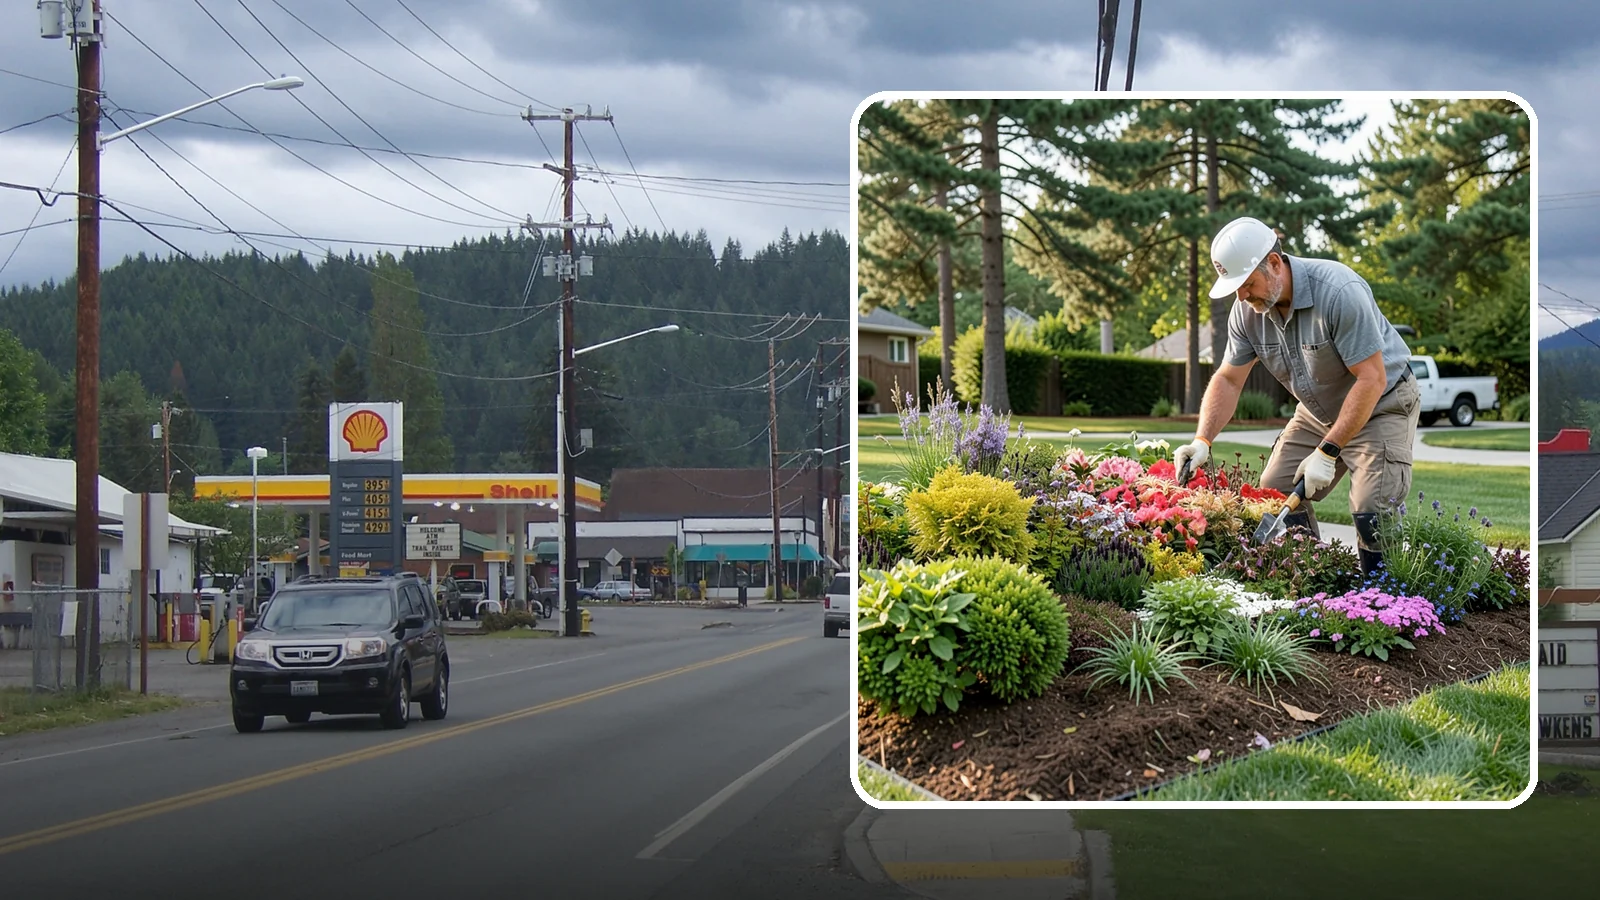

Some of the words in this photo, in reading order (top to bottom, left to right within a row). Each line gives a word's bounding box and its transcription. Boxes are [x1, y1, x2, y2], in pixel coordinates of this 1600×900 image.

[366, 480, 383, 490] 395
[490, 484, 547, 498] Shell
[366, 494, 383, 504] 405
[366, 508, 383, 518] 415
[366, 522, 383, 532] 429
